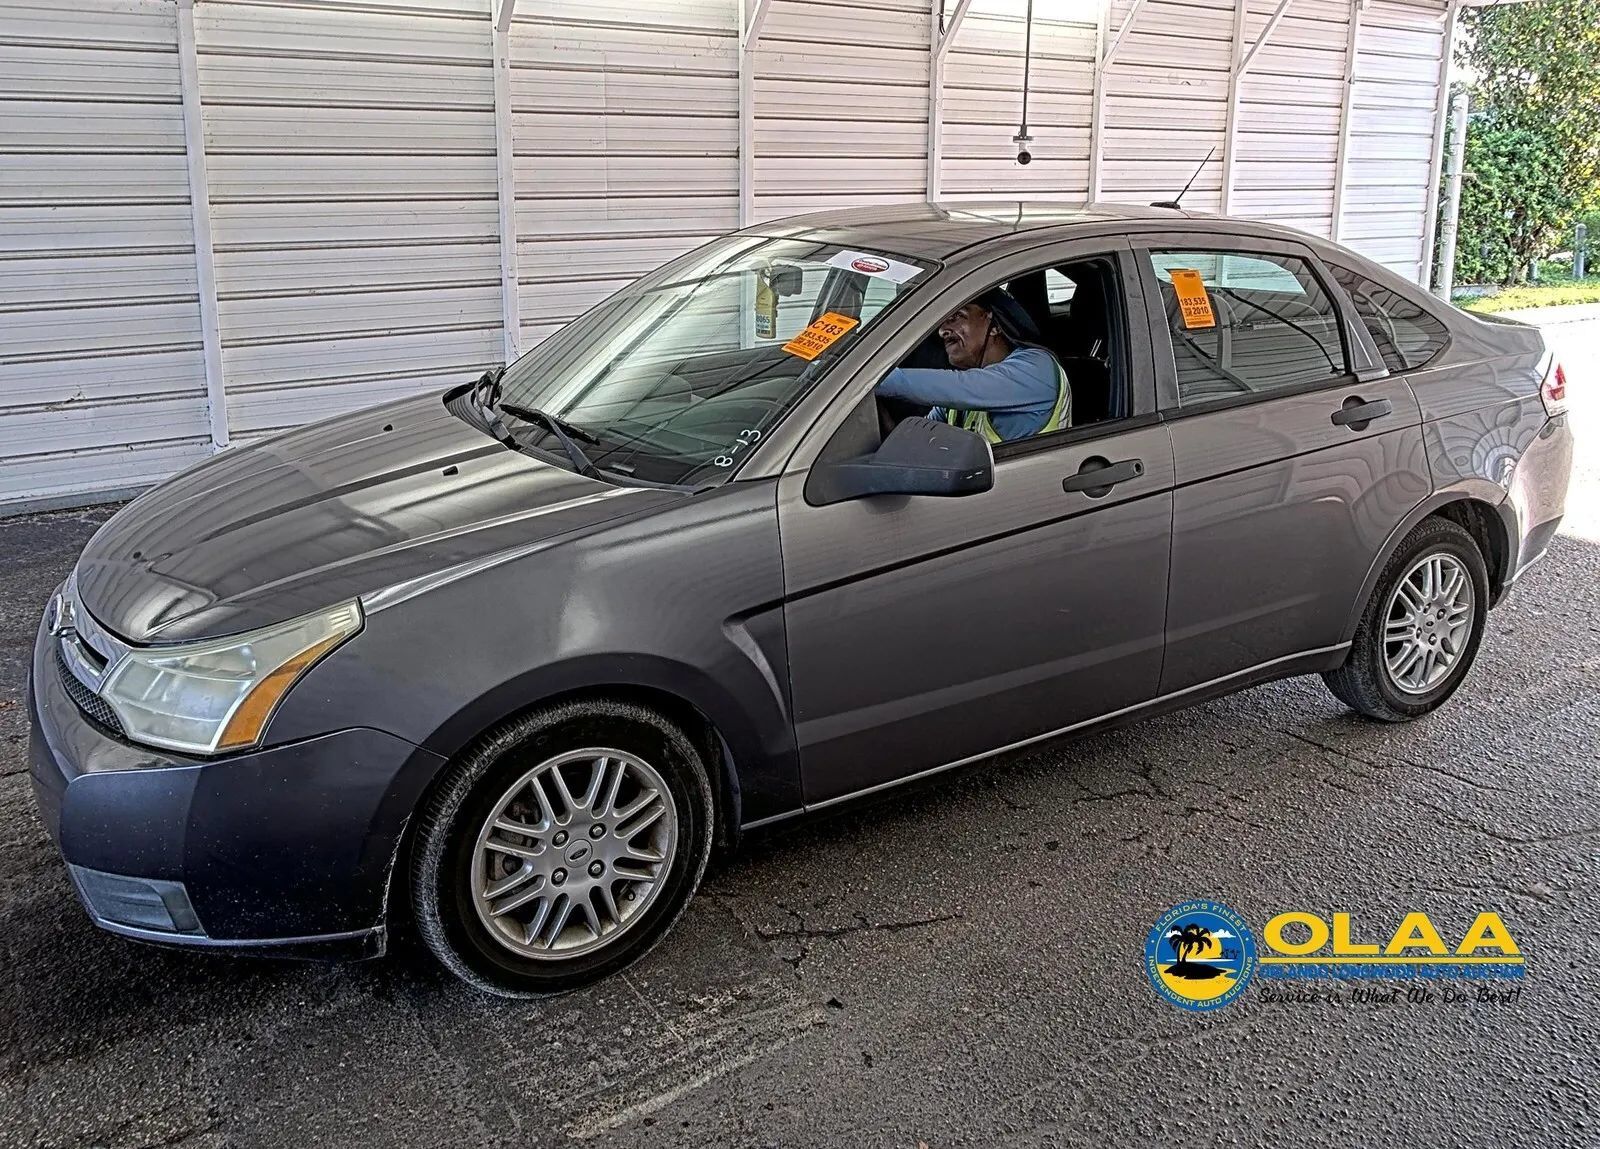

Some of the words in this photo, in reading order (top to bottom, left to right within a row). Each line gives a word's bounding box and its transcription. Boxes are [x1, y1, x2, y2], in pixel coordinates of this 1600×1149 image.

[1192, 307, 1209, 315] 2010
[812, 320, 844, 336] C183
[803, 341, 824, 351] 2010
[714, 429, 761, 467] 8-13
